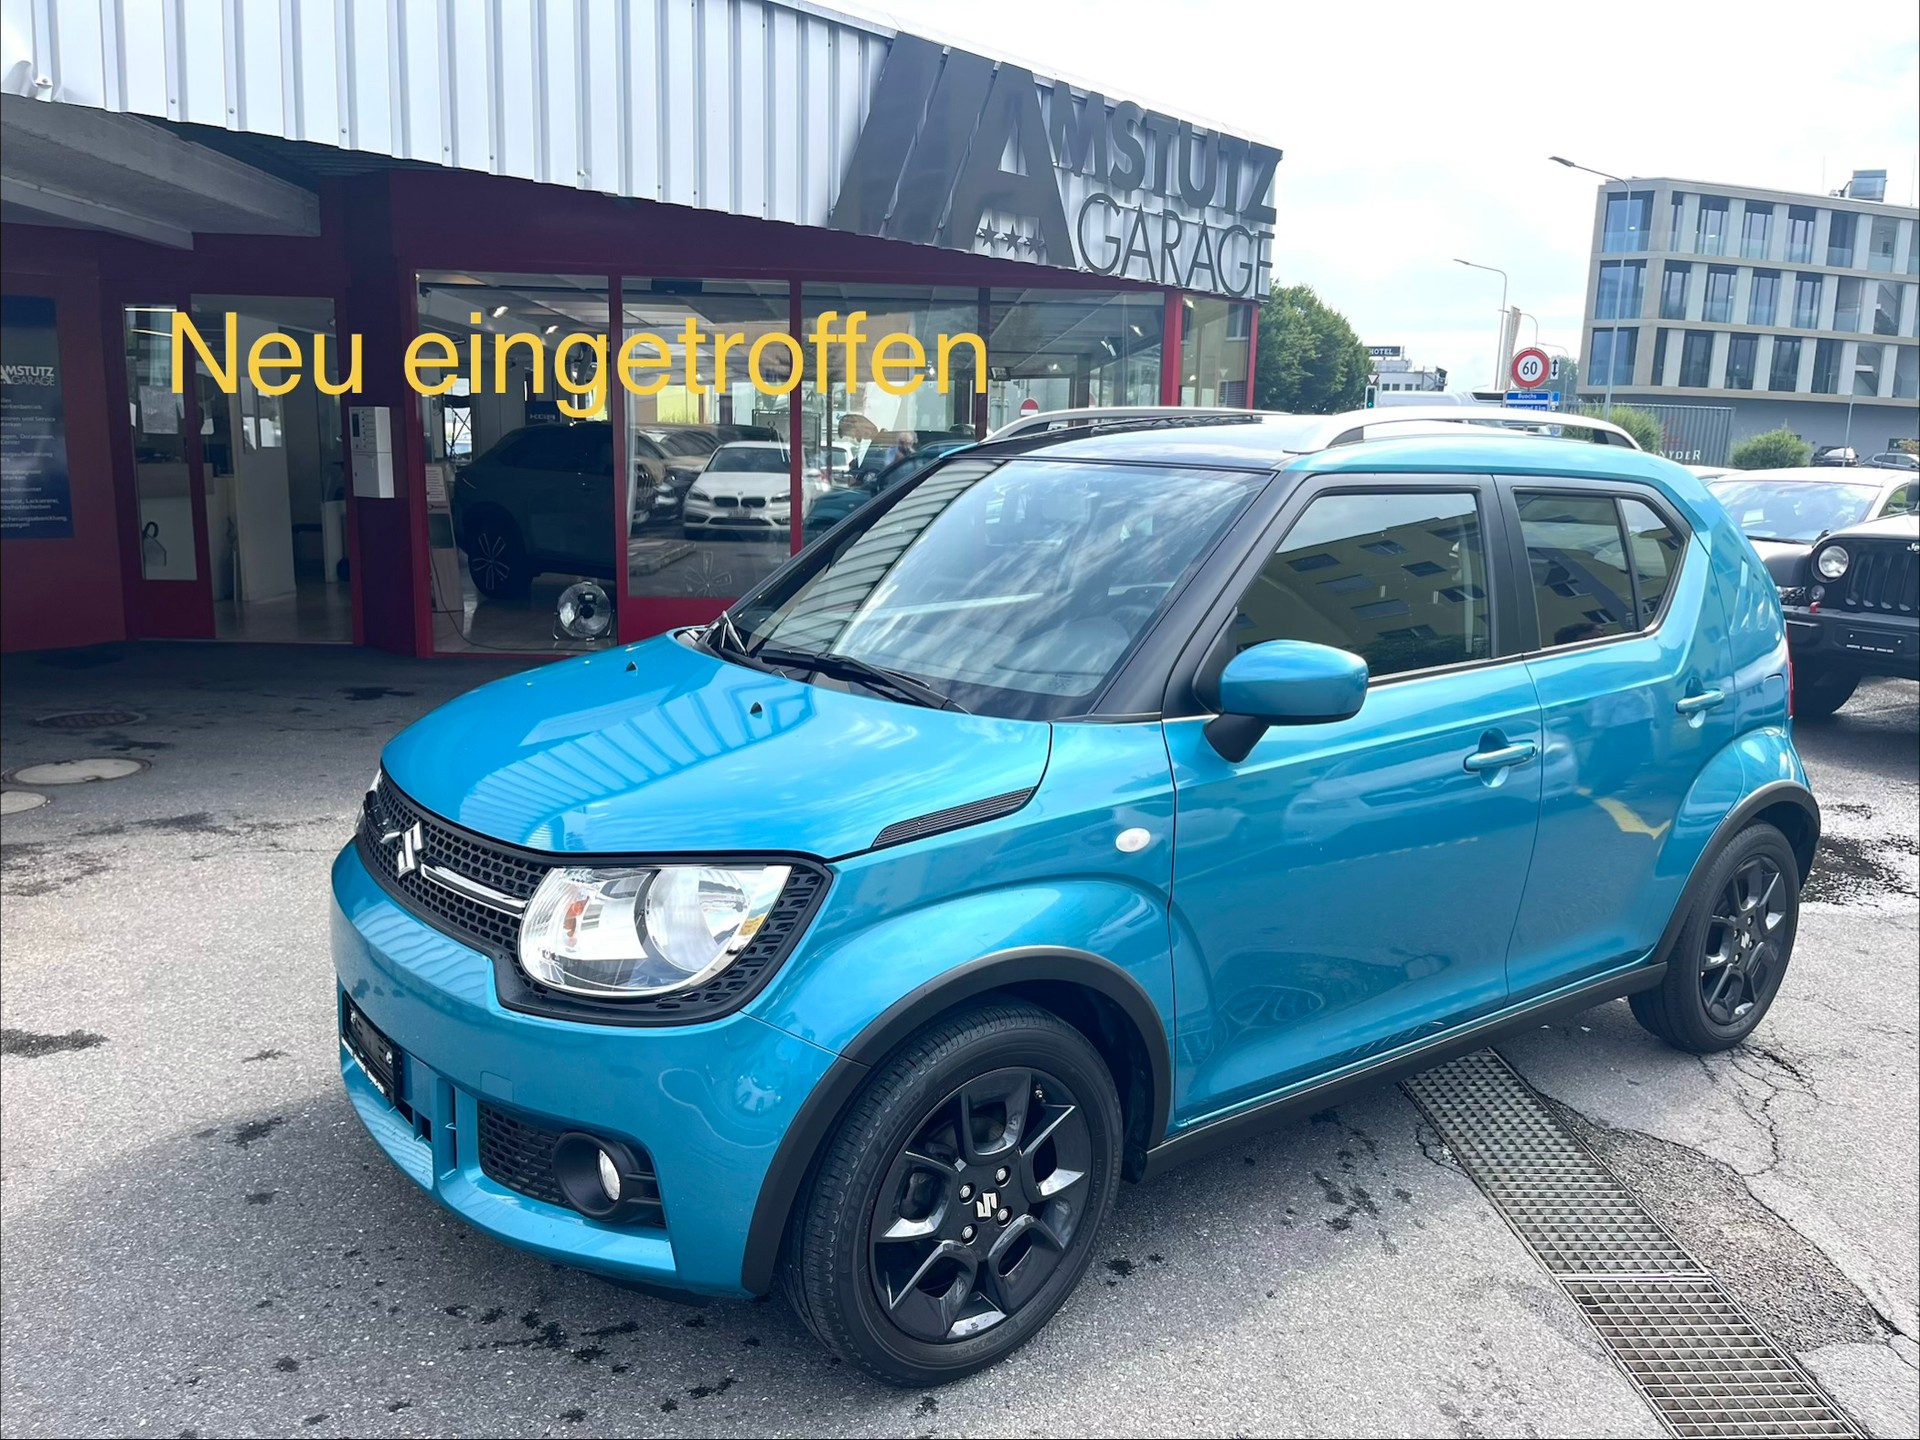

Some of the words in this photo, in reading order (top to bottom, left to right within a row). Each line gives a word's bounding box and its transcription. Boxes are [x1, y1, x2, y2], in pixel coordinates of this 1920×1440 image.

[934, 60, 1283, 268] AMSTUTZ
[1077, 192, 1275, 300] GARAGE
[1369, 348, 1393, 356] HOTEL
[1522, 361, 1538, 376] 60
[11, 375, 55, 386] GARAGE
